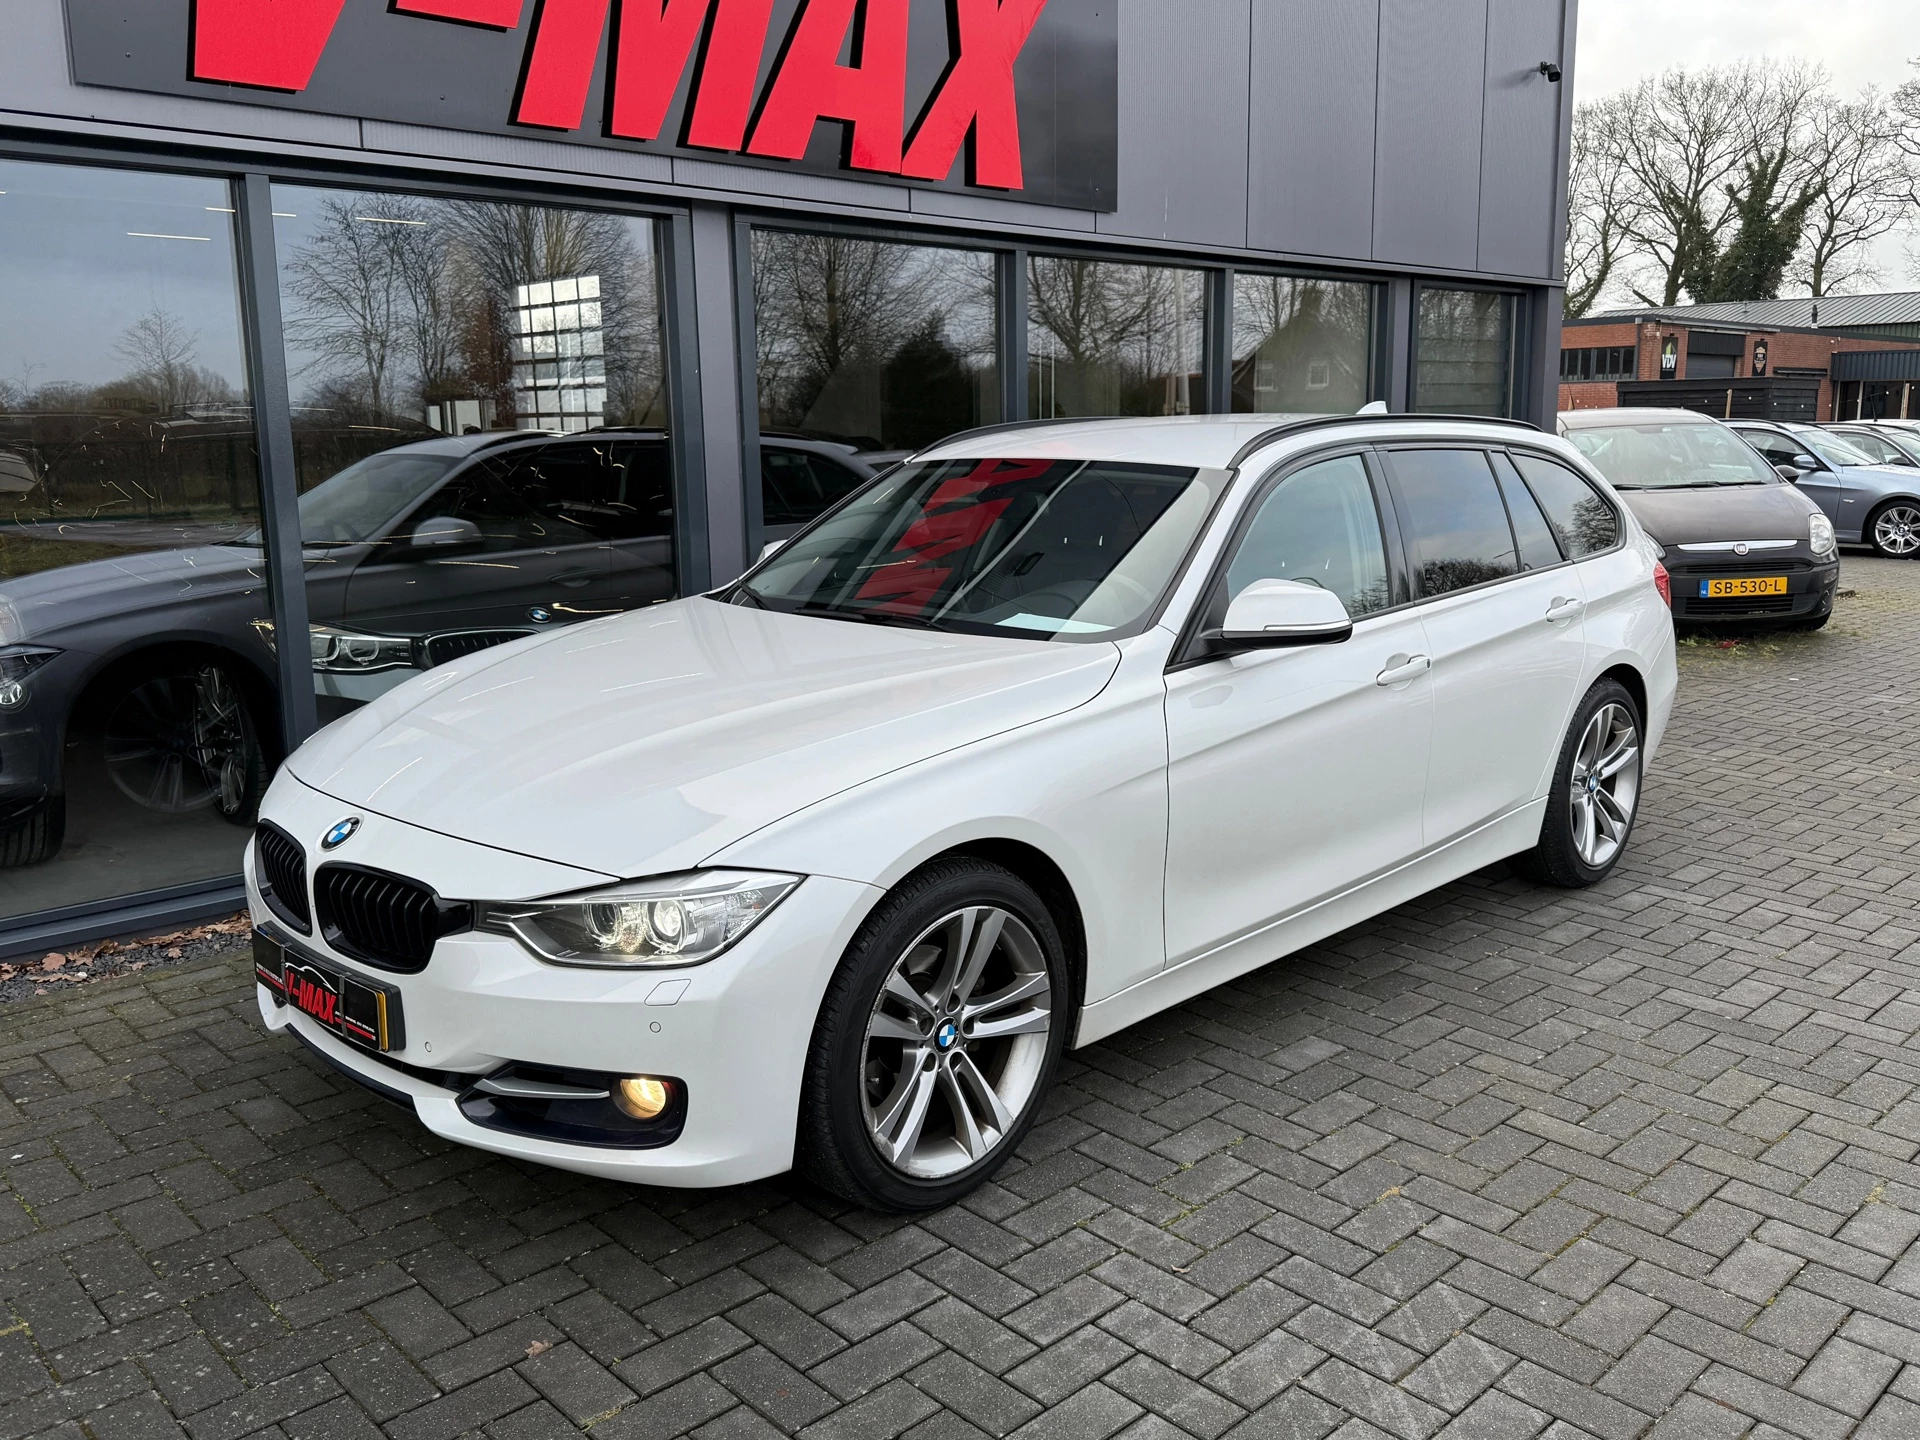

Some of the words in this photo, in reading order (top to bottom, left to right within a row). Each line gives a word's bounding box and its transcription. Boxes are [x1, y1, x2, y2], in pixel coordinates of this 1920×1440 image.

[193, 0, 1046, 190] MAX
[1662, 354, 1676, 368] VDV
[1714, 580, 1781, 594] SB-530-L
[285, 970, 336, 1024] V-MAX
